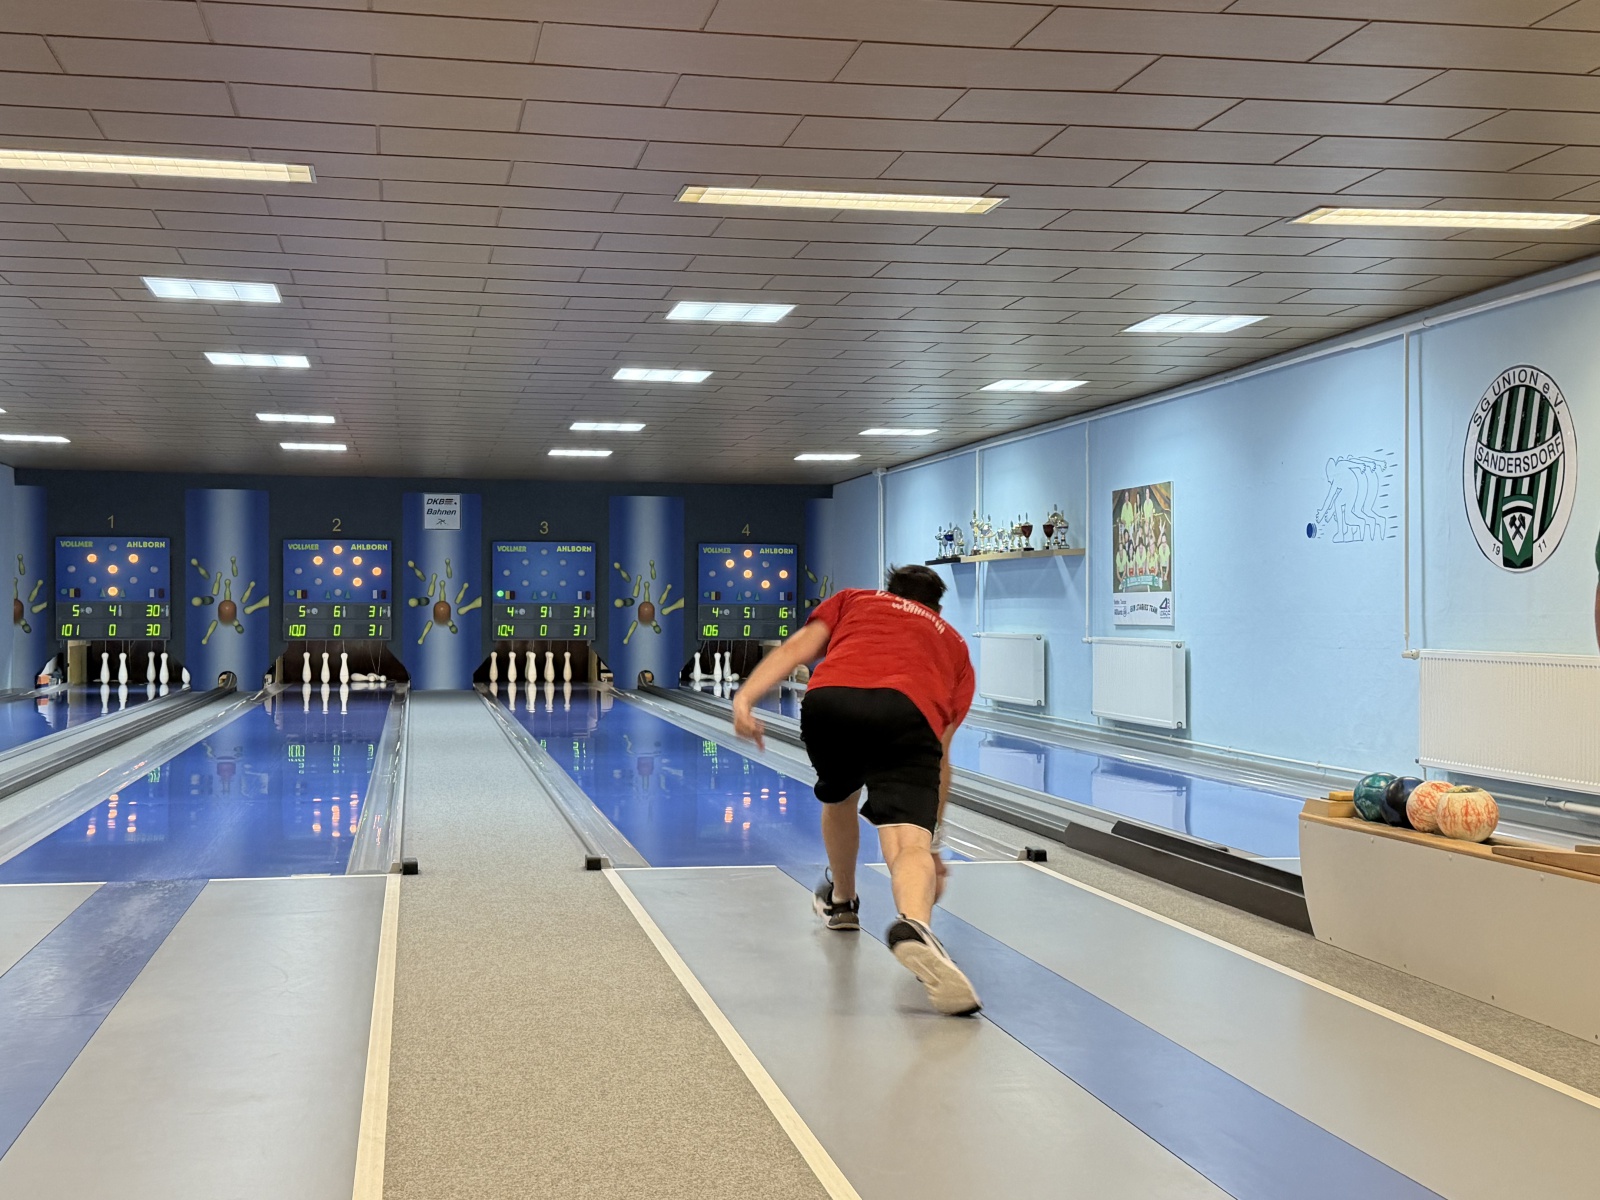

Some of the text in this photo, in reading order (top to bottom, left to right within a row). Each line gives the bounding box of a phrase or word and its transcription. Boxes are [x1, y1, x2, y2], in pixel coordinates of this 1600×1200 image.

[1473, 397, 1490, 428] SG
[1492, 369, 1539, 397] UNION
[1476, 436, 1563, 473] SANDERSDORF
[426, 508, 457, 516] Bahnen
[107, 515, 114, 528] 1
[332, 518, 342, 532] 2
[540, 521, 549, 534] 3
[742, 524, 751, 536] 4
[556, 545, 592, 553] AHLBORN
[1492, 543, 1501, 556] 19
[1538, 539, 1547, 553] 11
[72, 604, 161, 617] 5 4 30
[299, 605, 383, 618] 5 6 31
[507, 606, 587, 618] 4 9 31
[712, 606, 788, 619] 4 5 16
[61, 624, 161, 637] 101 0 30
[288, 624, 383, 637] 100 0 31
[497, 624, 587, 637] 104 0 31
[702, 624, 788, 637] 106 0 16
